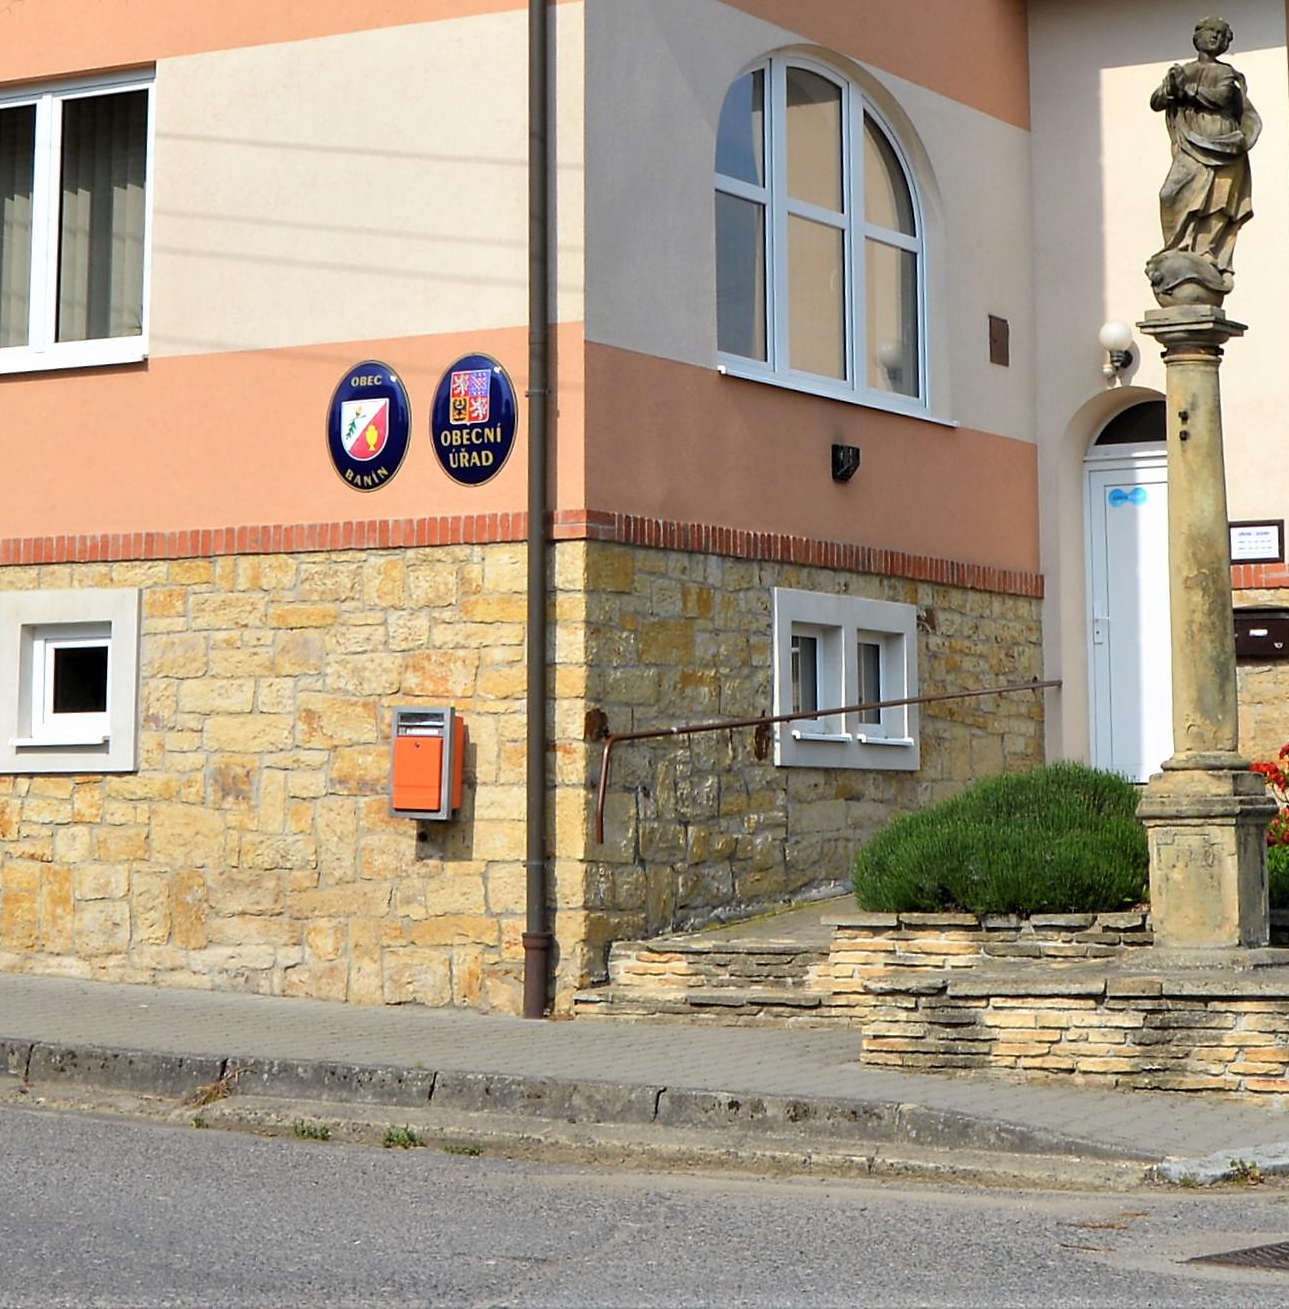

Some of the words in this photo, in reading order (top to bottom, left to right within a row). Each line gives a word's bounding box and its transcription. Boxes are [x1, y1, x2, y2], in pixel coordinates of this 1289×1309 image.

[351, 375, 382, 387] OBEC
[441, 423, 502, 446] OBECNÍ
[449, 448, 494, 468] ÚŘAD
[345, 466, 389, 487] BANÍN
